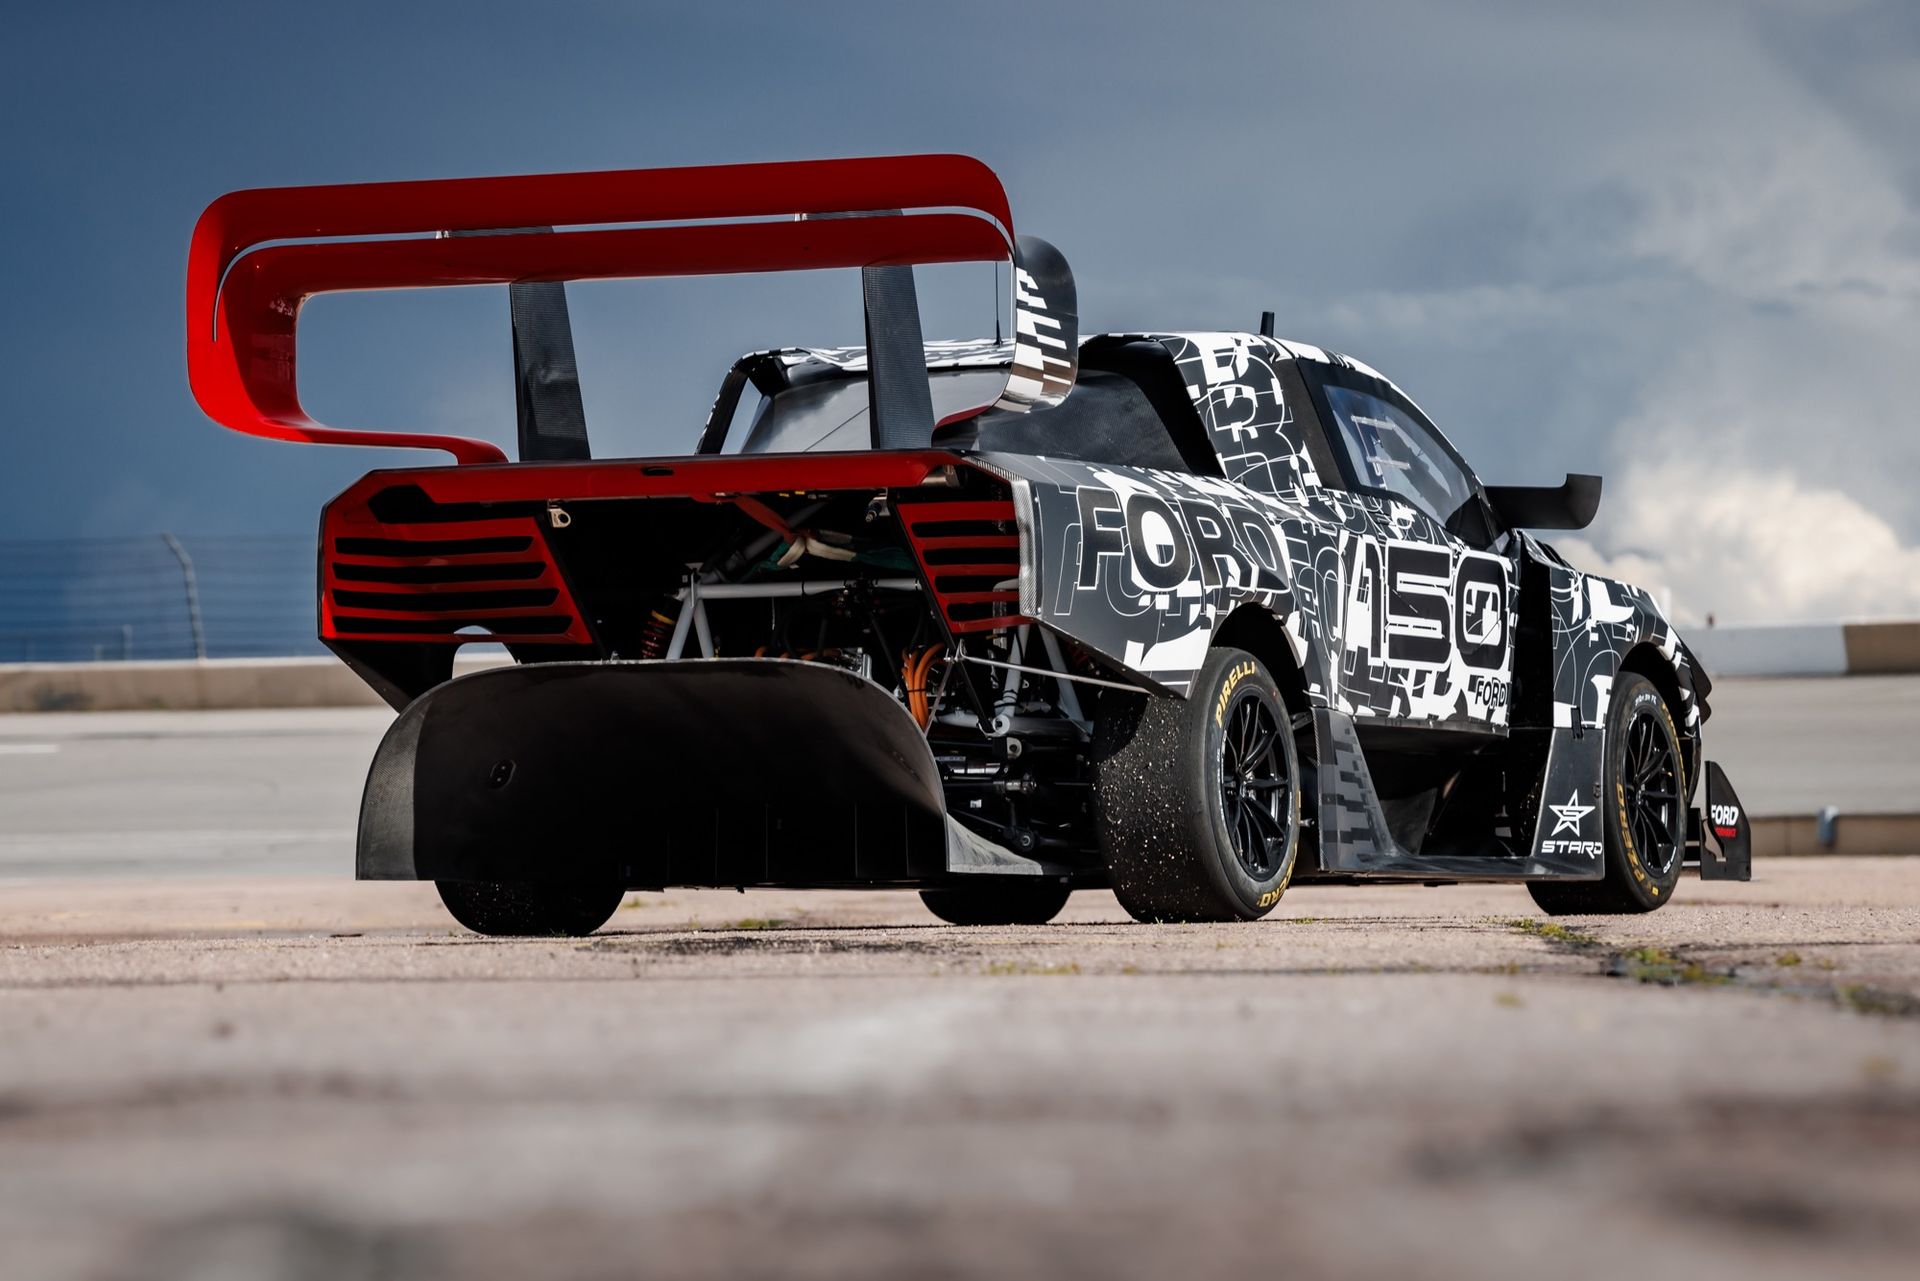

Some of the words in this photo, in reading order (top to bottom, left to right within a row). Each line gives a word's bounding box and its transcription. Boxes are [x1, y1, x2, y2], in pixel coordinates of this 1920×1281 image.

[1077, 486, 1290, 593] FORD
[1363, 538, 1510, 671] 150
[1215, 661, 1256, 728] PIRELLI
[1475, 680, 1507, 708] FORD
[1711, 805, 1739, 826] FORD
[1541, 840, 1603, 860] STARD
